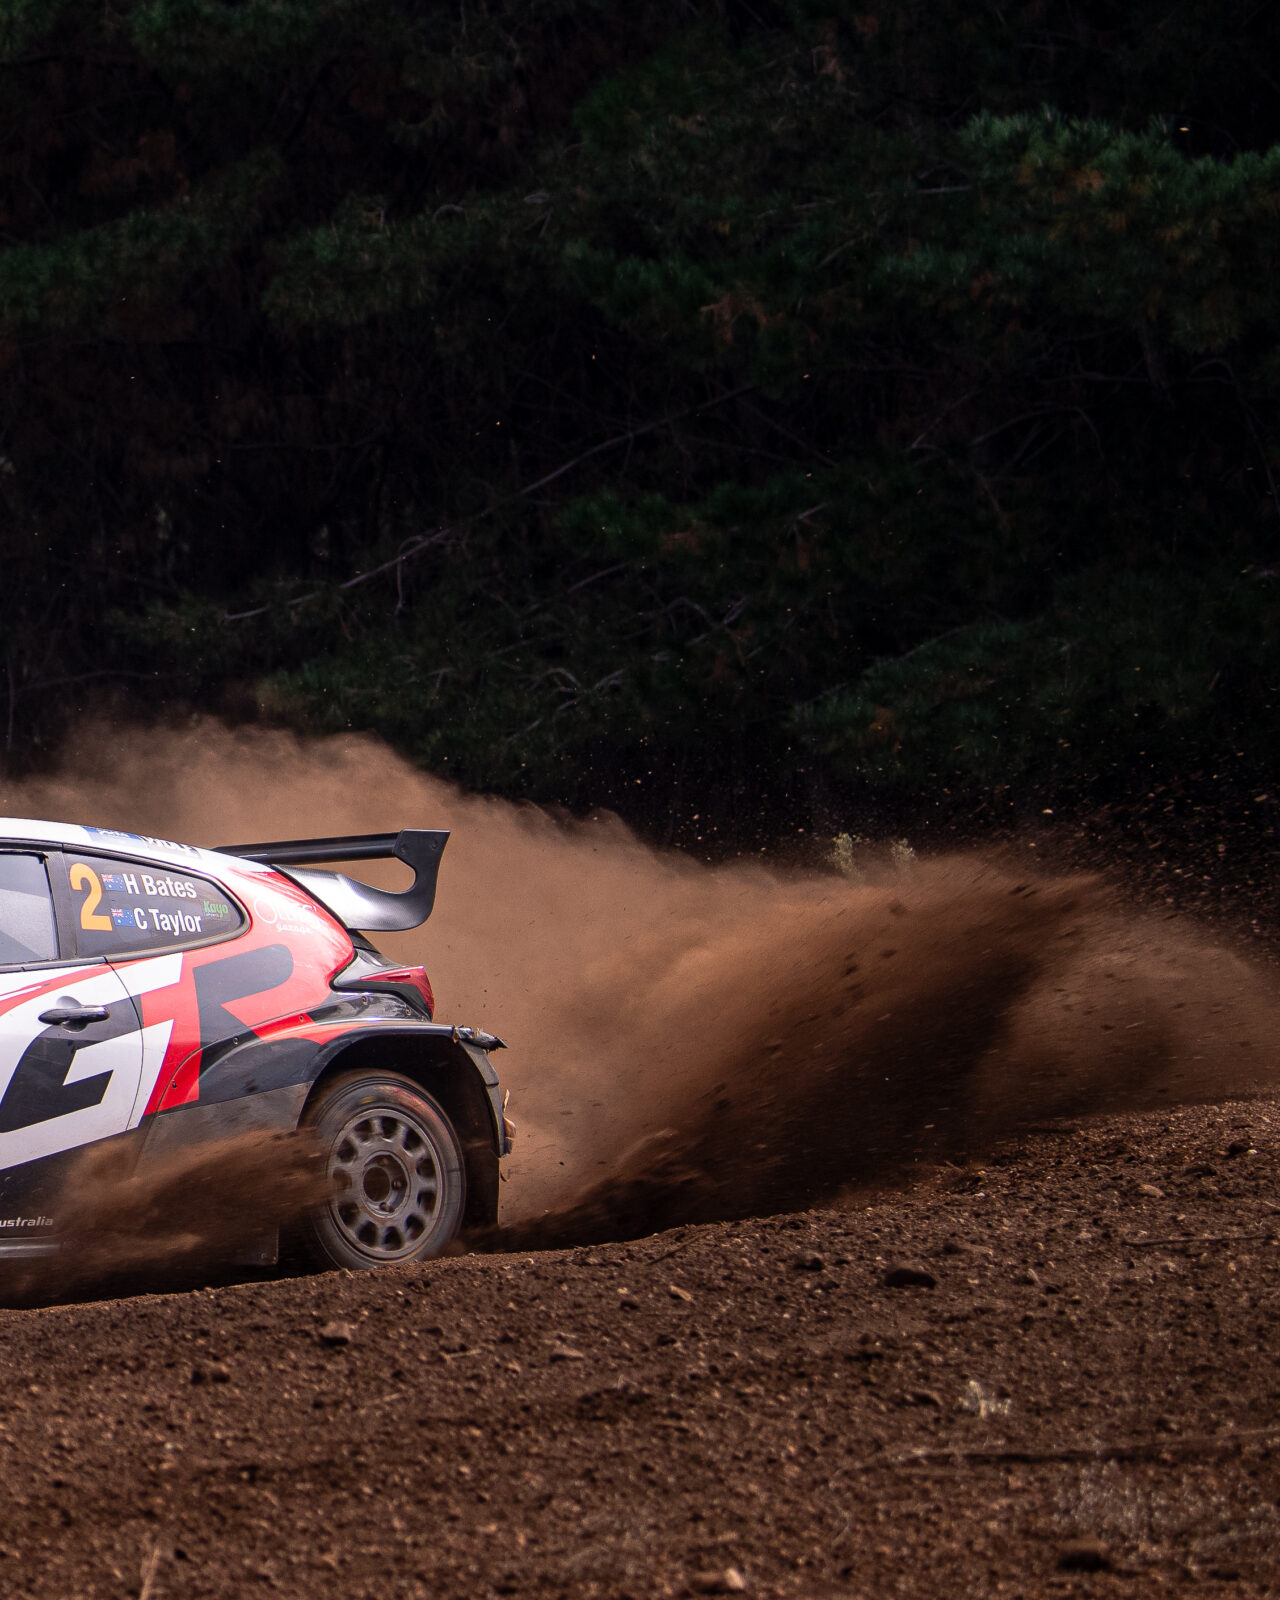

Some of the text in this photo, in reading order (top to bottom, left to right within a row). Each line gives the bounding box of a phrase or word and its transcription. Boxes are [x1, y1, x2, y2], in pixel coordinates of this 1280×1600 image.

[69, 862, 113, 932] 2
[123, 873, 198, 899] H Bates
[133, 907, 203, 937] C Taylor
[203, 900, 230, 918] Kayo
